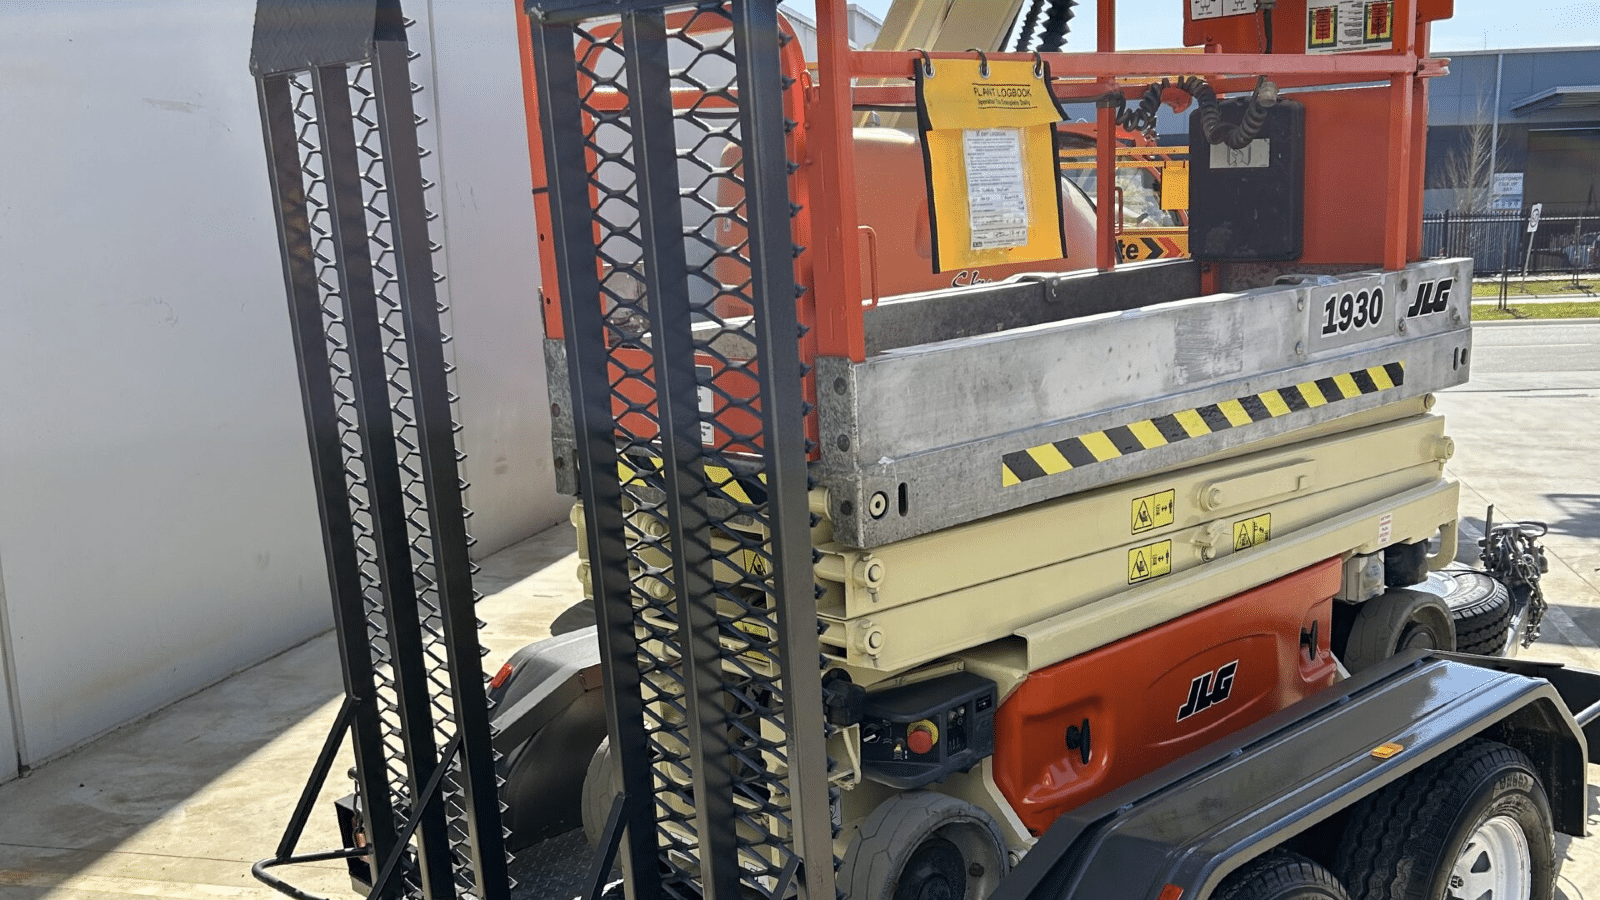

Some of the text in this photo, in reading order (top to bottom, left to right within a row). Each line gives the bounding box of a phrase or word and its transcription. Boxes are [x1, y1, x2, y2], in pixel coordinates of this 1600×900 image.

[973, 87, 1032, 97] PLANT LOGBOOK
[1321, 277, 1454, 337] 1930 JLG
[1176, 659, 1239, 722] JLG
